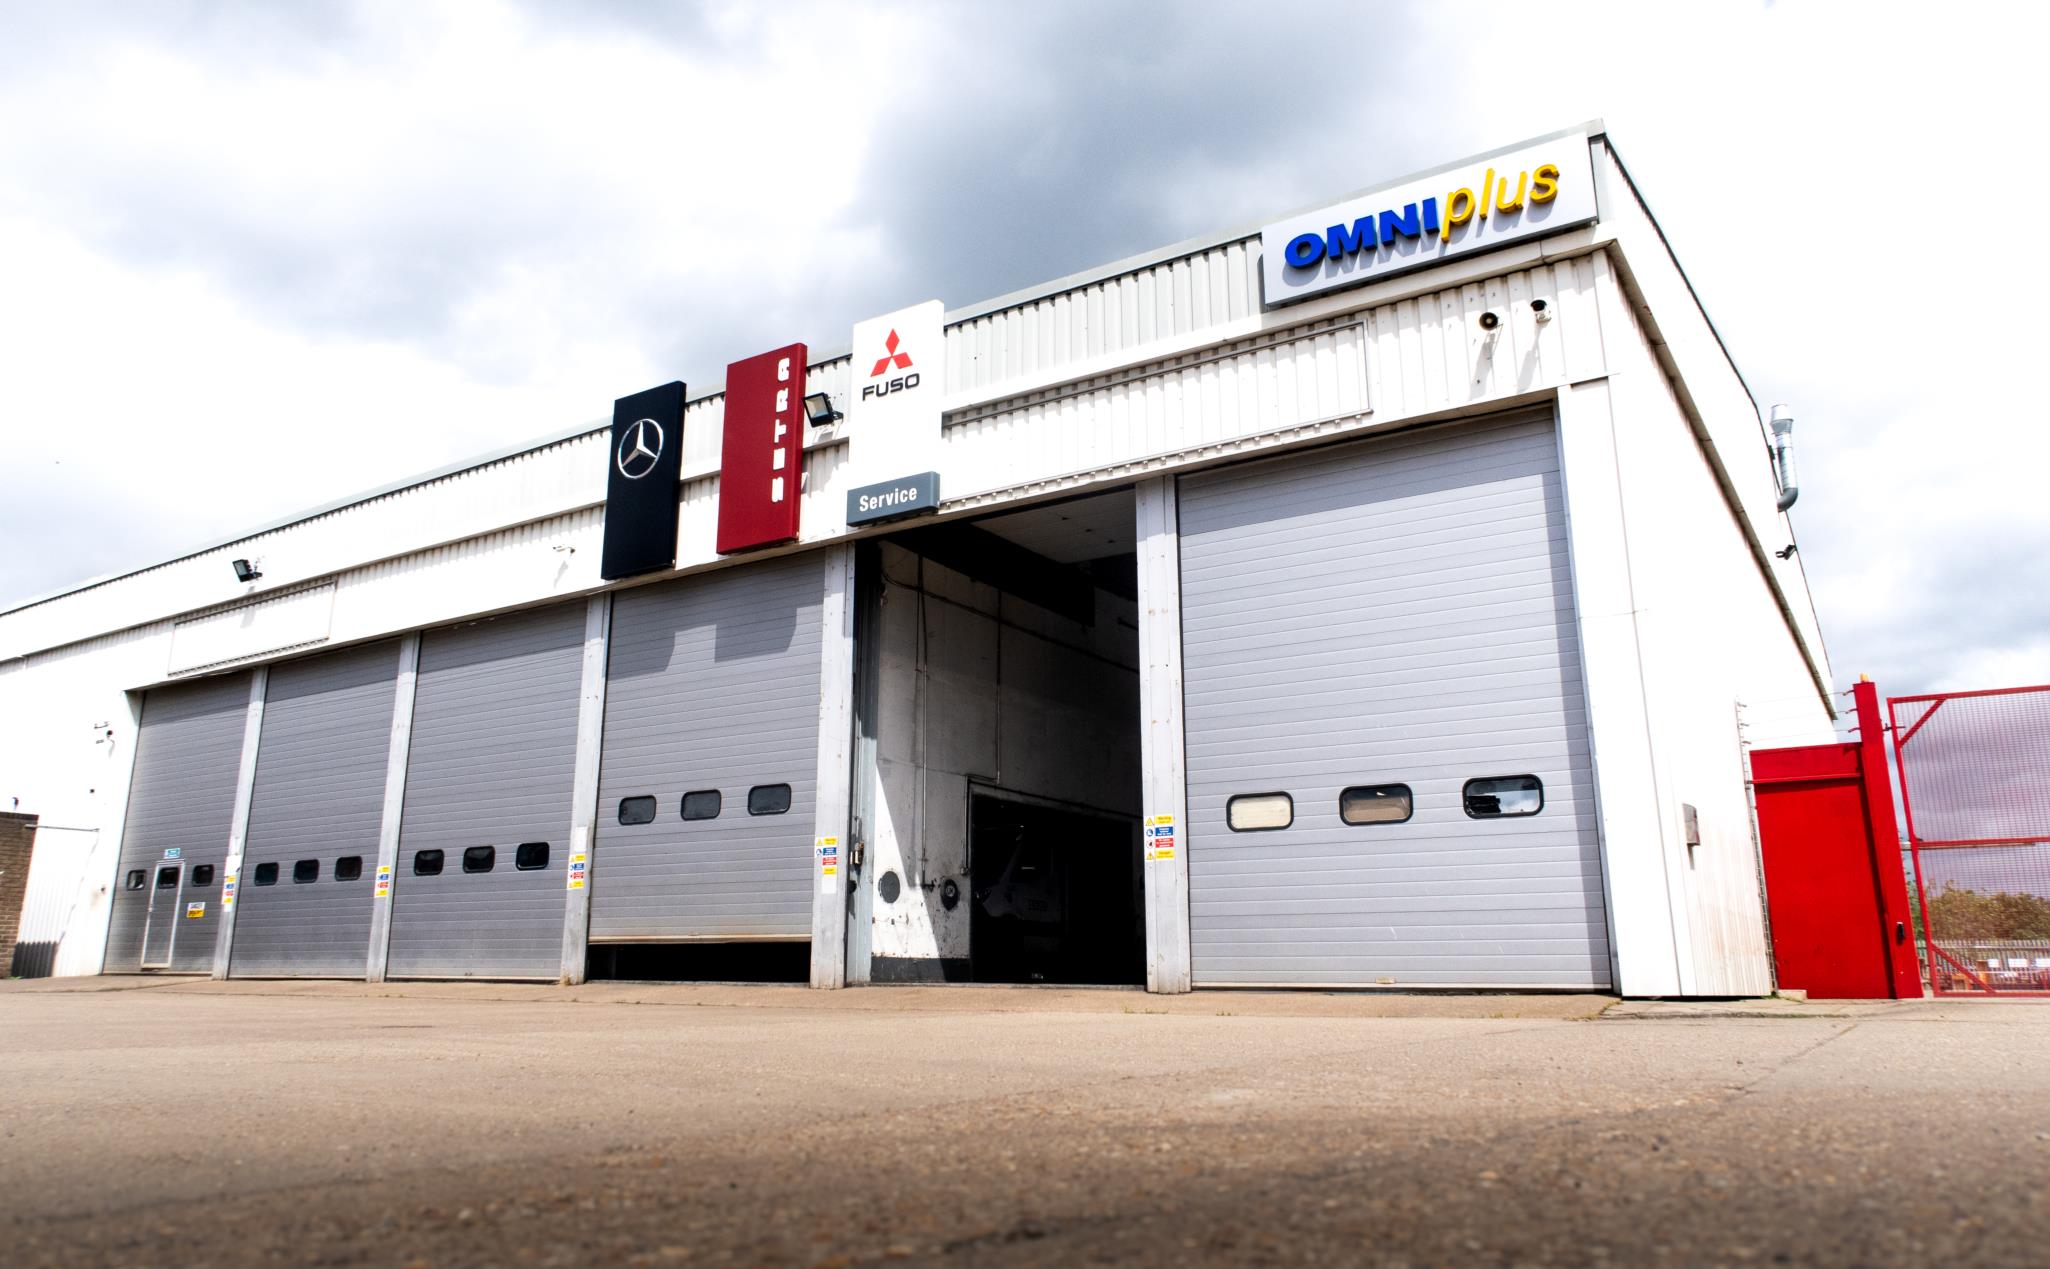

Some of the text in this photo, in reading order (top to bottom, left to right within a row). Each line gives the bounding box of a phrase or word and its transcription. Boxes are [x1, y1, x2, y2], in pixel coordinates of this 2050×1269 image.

[1285, 163, 1560, 268] OMNIplus
[862, 373, 920, 401] FUSO
[859, 487, 917, 512] Service
